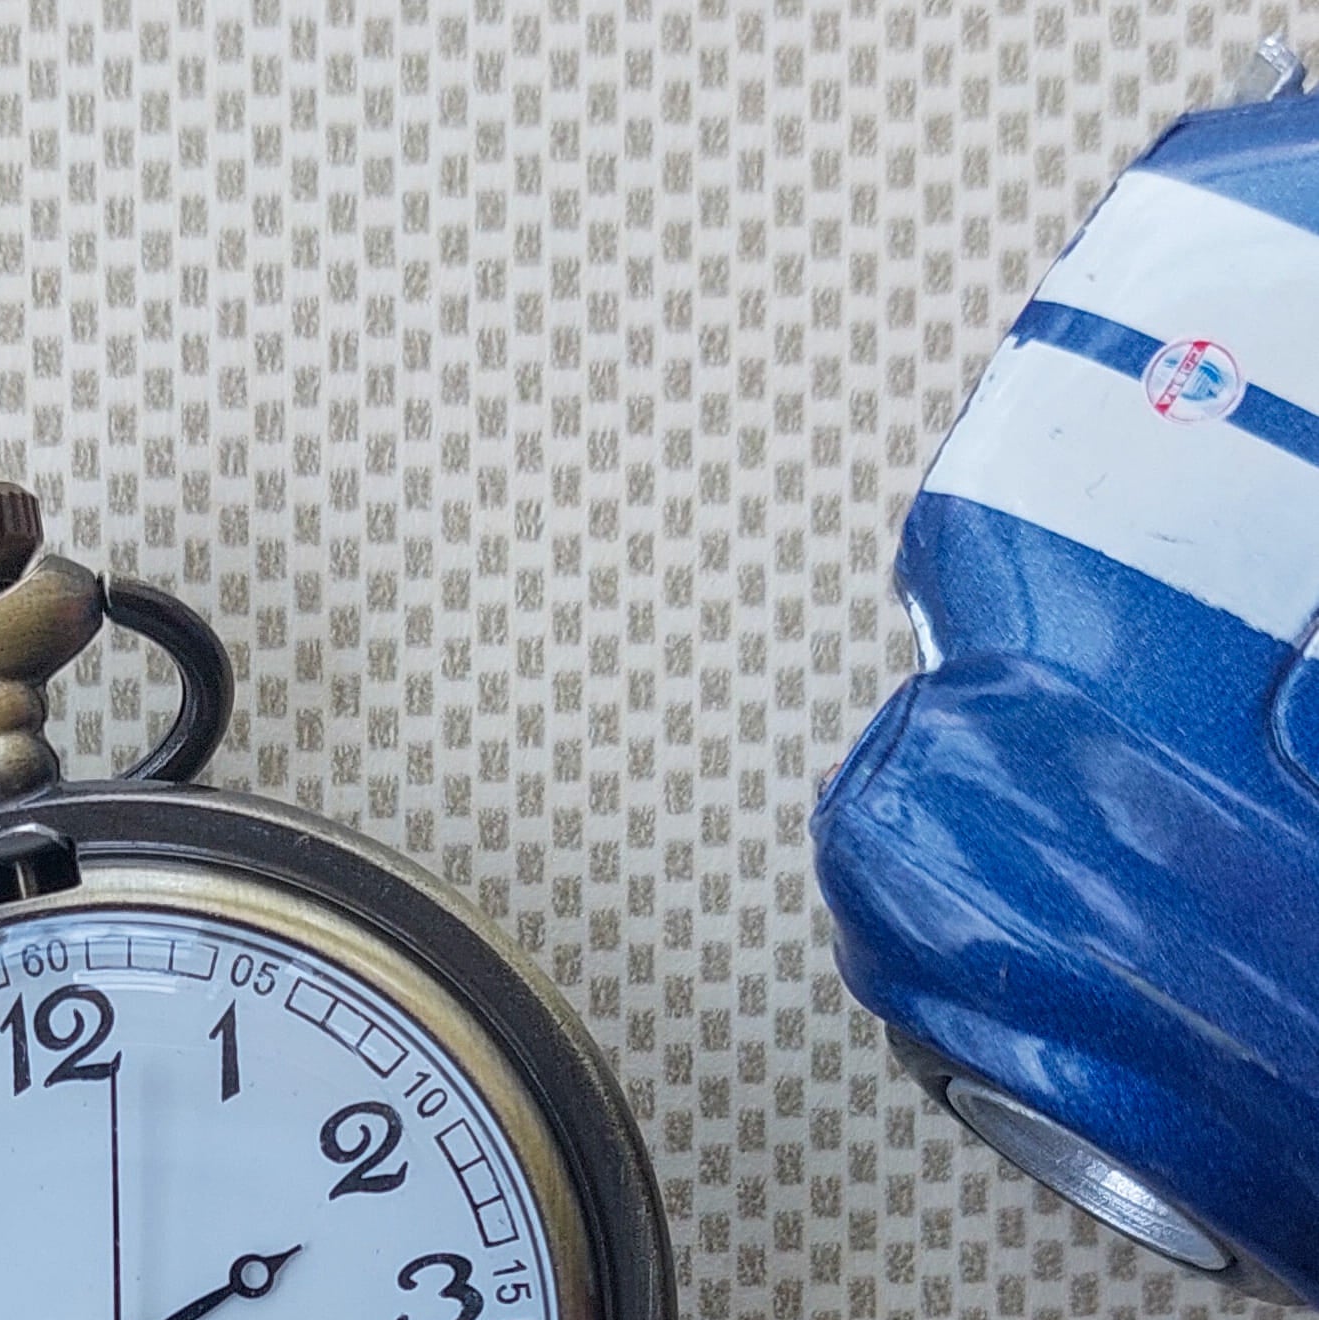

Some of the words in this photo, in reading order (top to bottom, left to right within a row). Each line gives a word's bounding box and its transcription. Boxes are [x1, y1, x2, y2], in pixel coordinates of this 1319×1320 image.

[21, 939, 68, 978] 60
[230, 953, 280, 996] 05
[0, 983, 121, 1097] 12
[208, 999, 240, 1103] 1
[403, 1070, 448, 1119] 10
[319, 1100, 409, 1201] 2
[492, 1258, 533, 1305] 15
